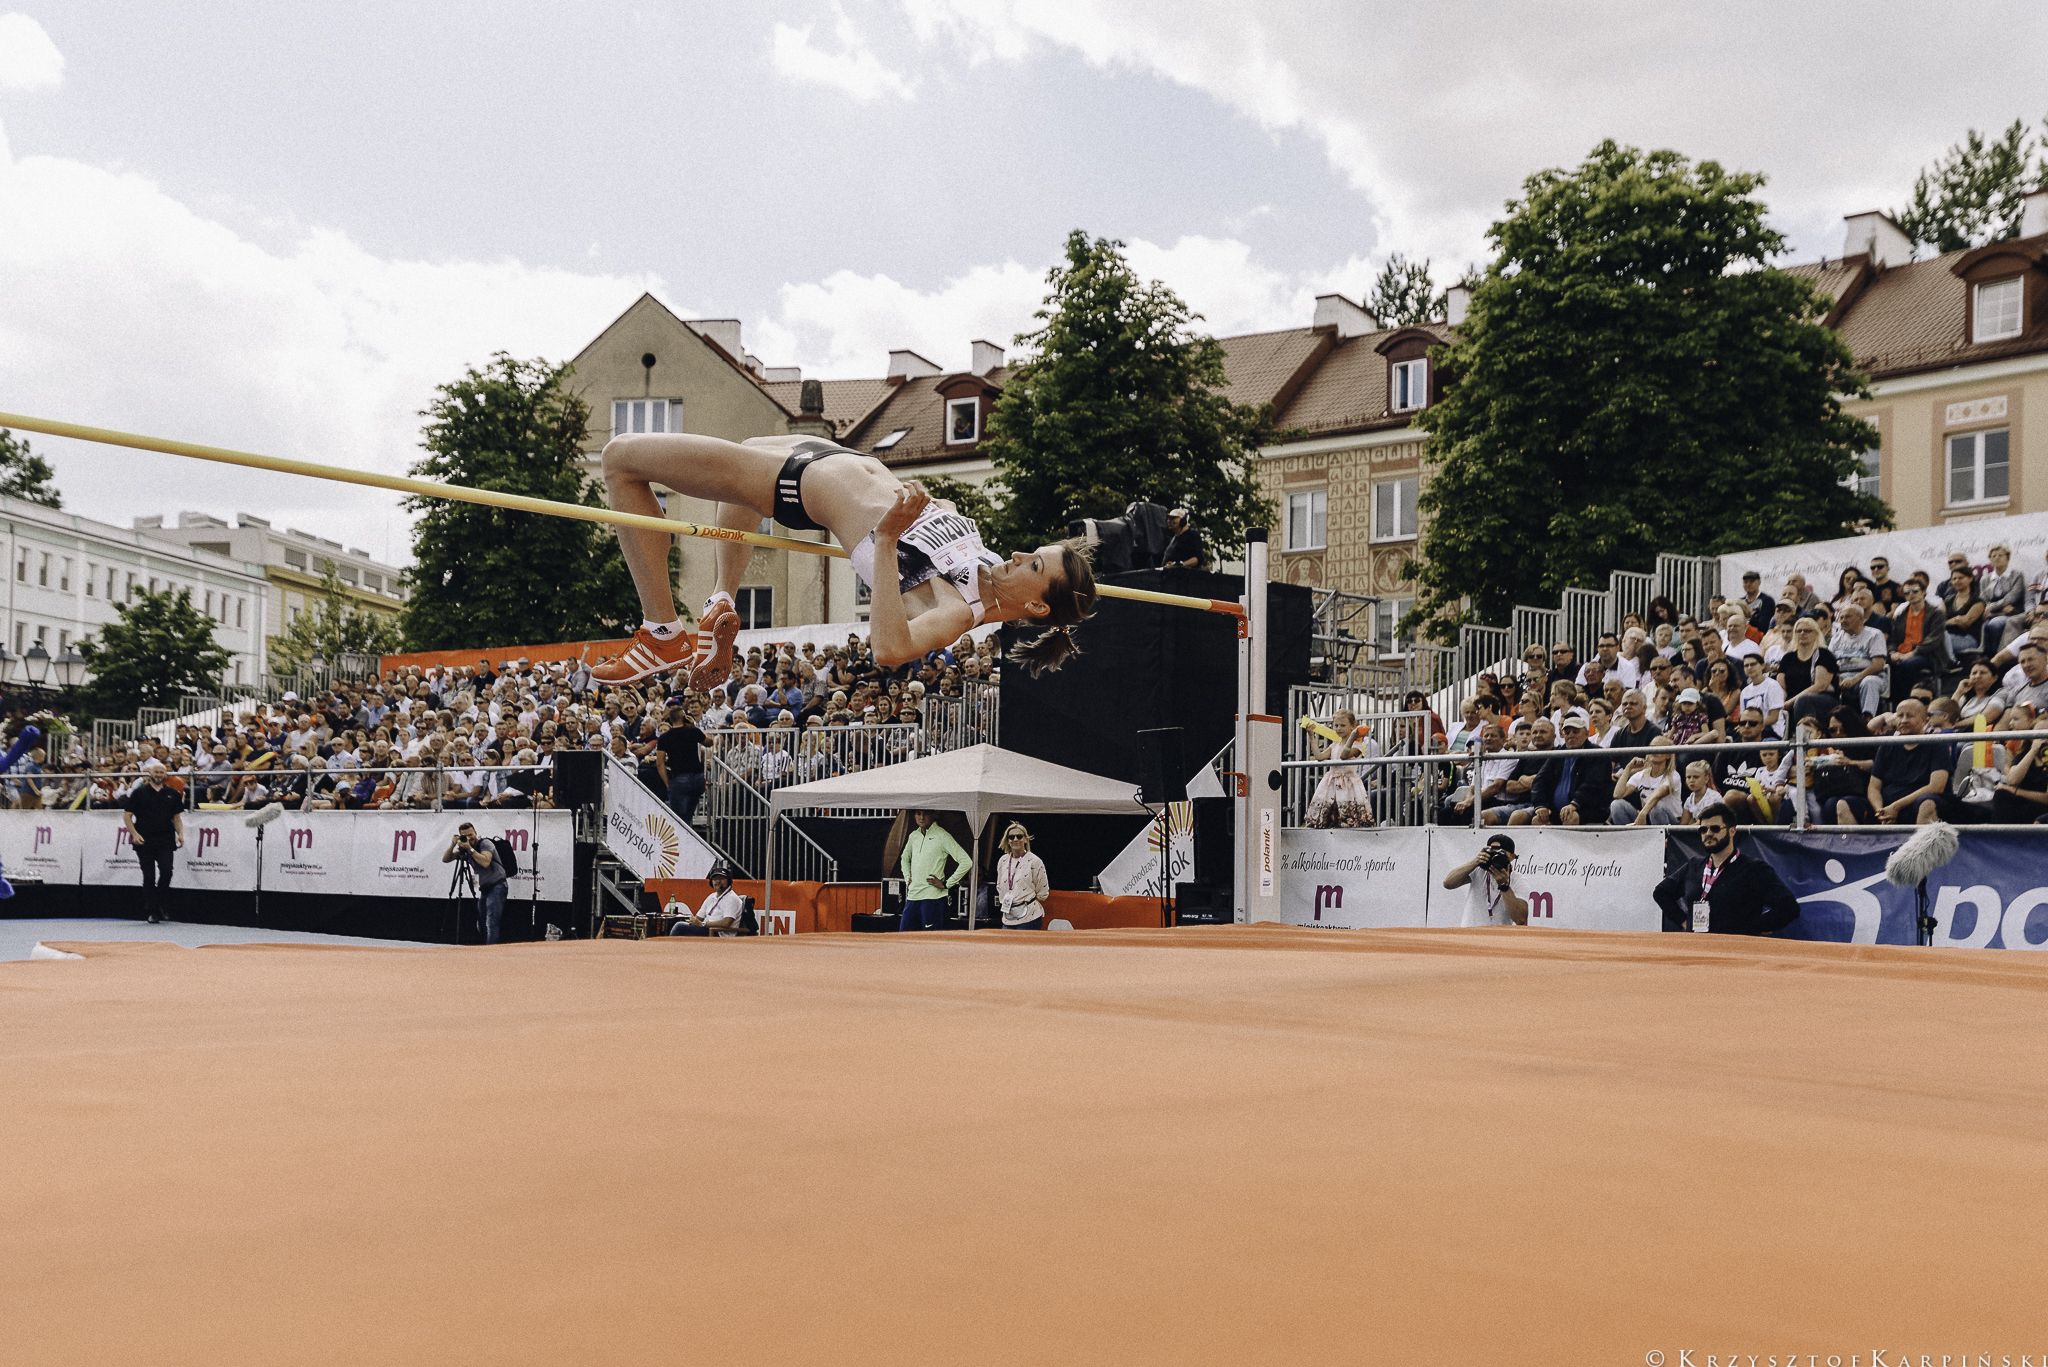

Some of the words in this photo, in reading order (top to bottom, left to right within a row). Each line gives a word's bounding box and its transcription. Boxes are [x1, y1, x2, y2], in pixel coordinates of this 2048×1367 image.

[700, 527, 745, 542] polanik
[610, 812, 655, 861] Białystok
[1263, 827, 1272, 874] polanik
[1122, 856, 1158, 894] wschodzący
[1291, 851, 1362, 872] alkoholu=100%
[1364, 856, 1396, 880] sportu
[1581, 860, 1622, 886] sportu
